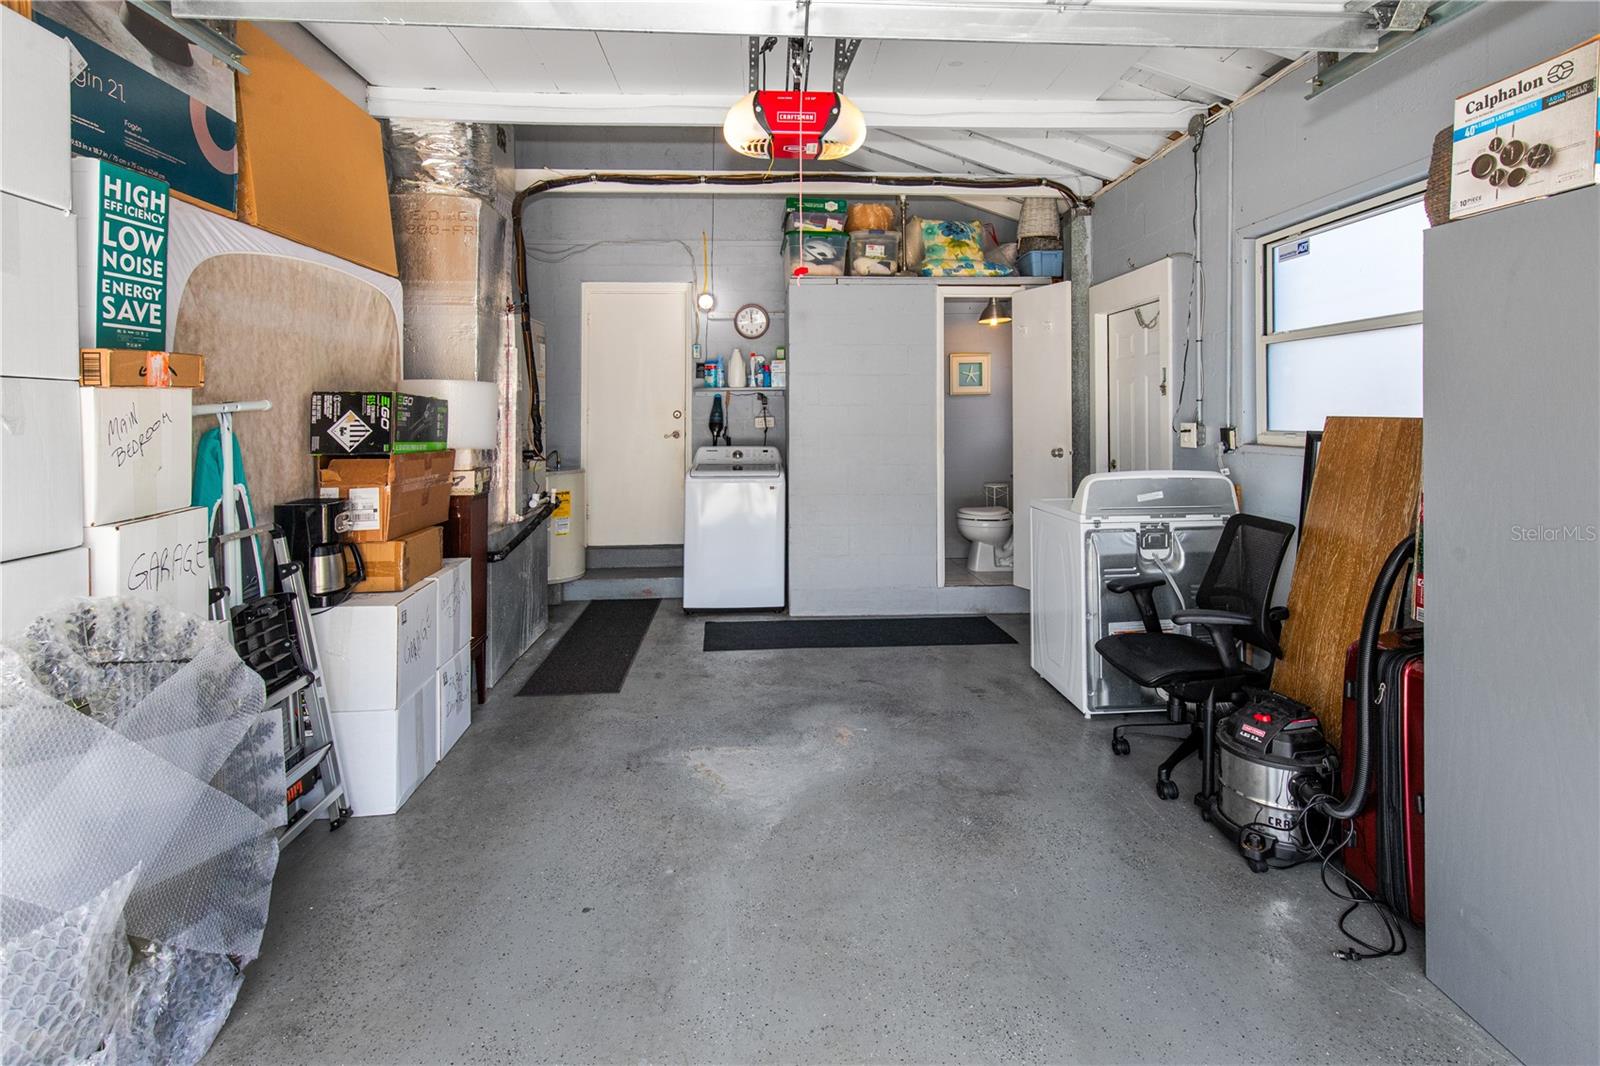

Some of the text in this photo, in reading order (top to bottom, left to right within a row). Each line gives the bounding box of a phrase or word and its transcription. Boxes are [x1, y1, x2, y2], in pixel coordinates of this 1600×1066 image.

[74, 68, 103, 92] gin
[1465, 76, 1544, 115] Calphalon
[104, 174, 166, 214] HIGH
[104, 199, 165, 224] EFFICIENCY
[102, 220, 164, 257] LOW
[102, 249, 163, 279] NOISE
[102, 278, 163, 301] ENERGY
[102, 295, 162, 325] SAVE
[107, 402, 139, 446] MAIN
[381, 395, 390, 431] EGO
[111, 411, 172, 468] BEDROOM
[128, 541, 208, 592] GARAGE
